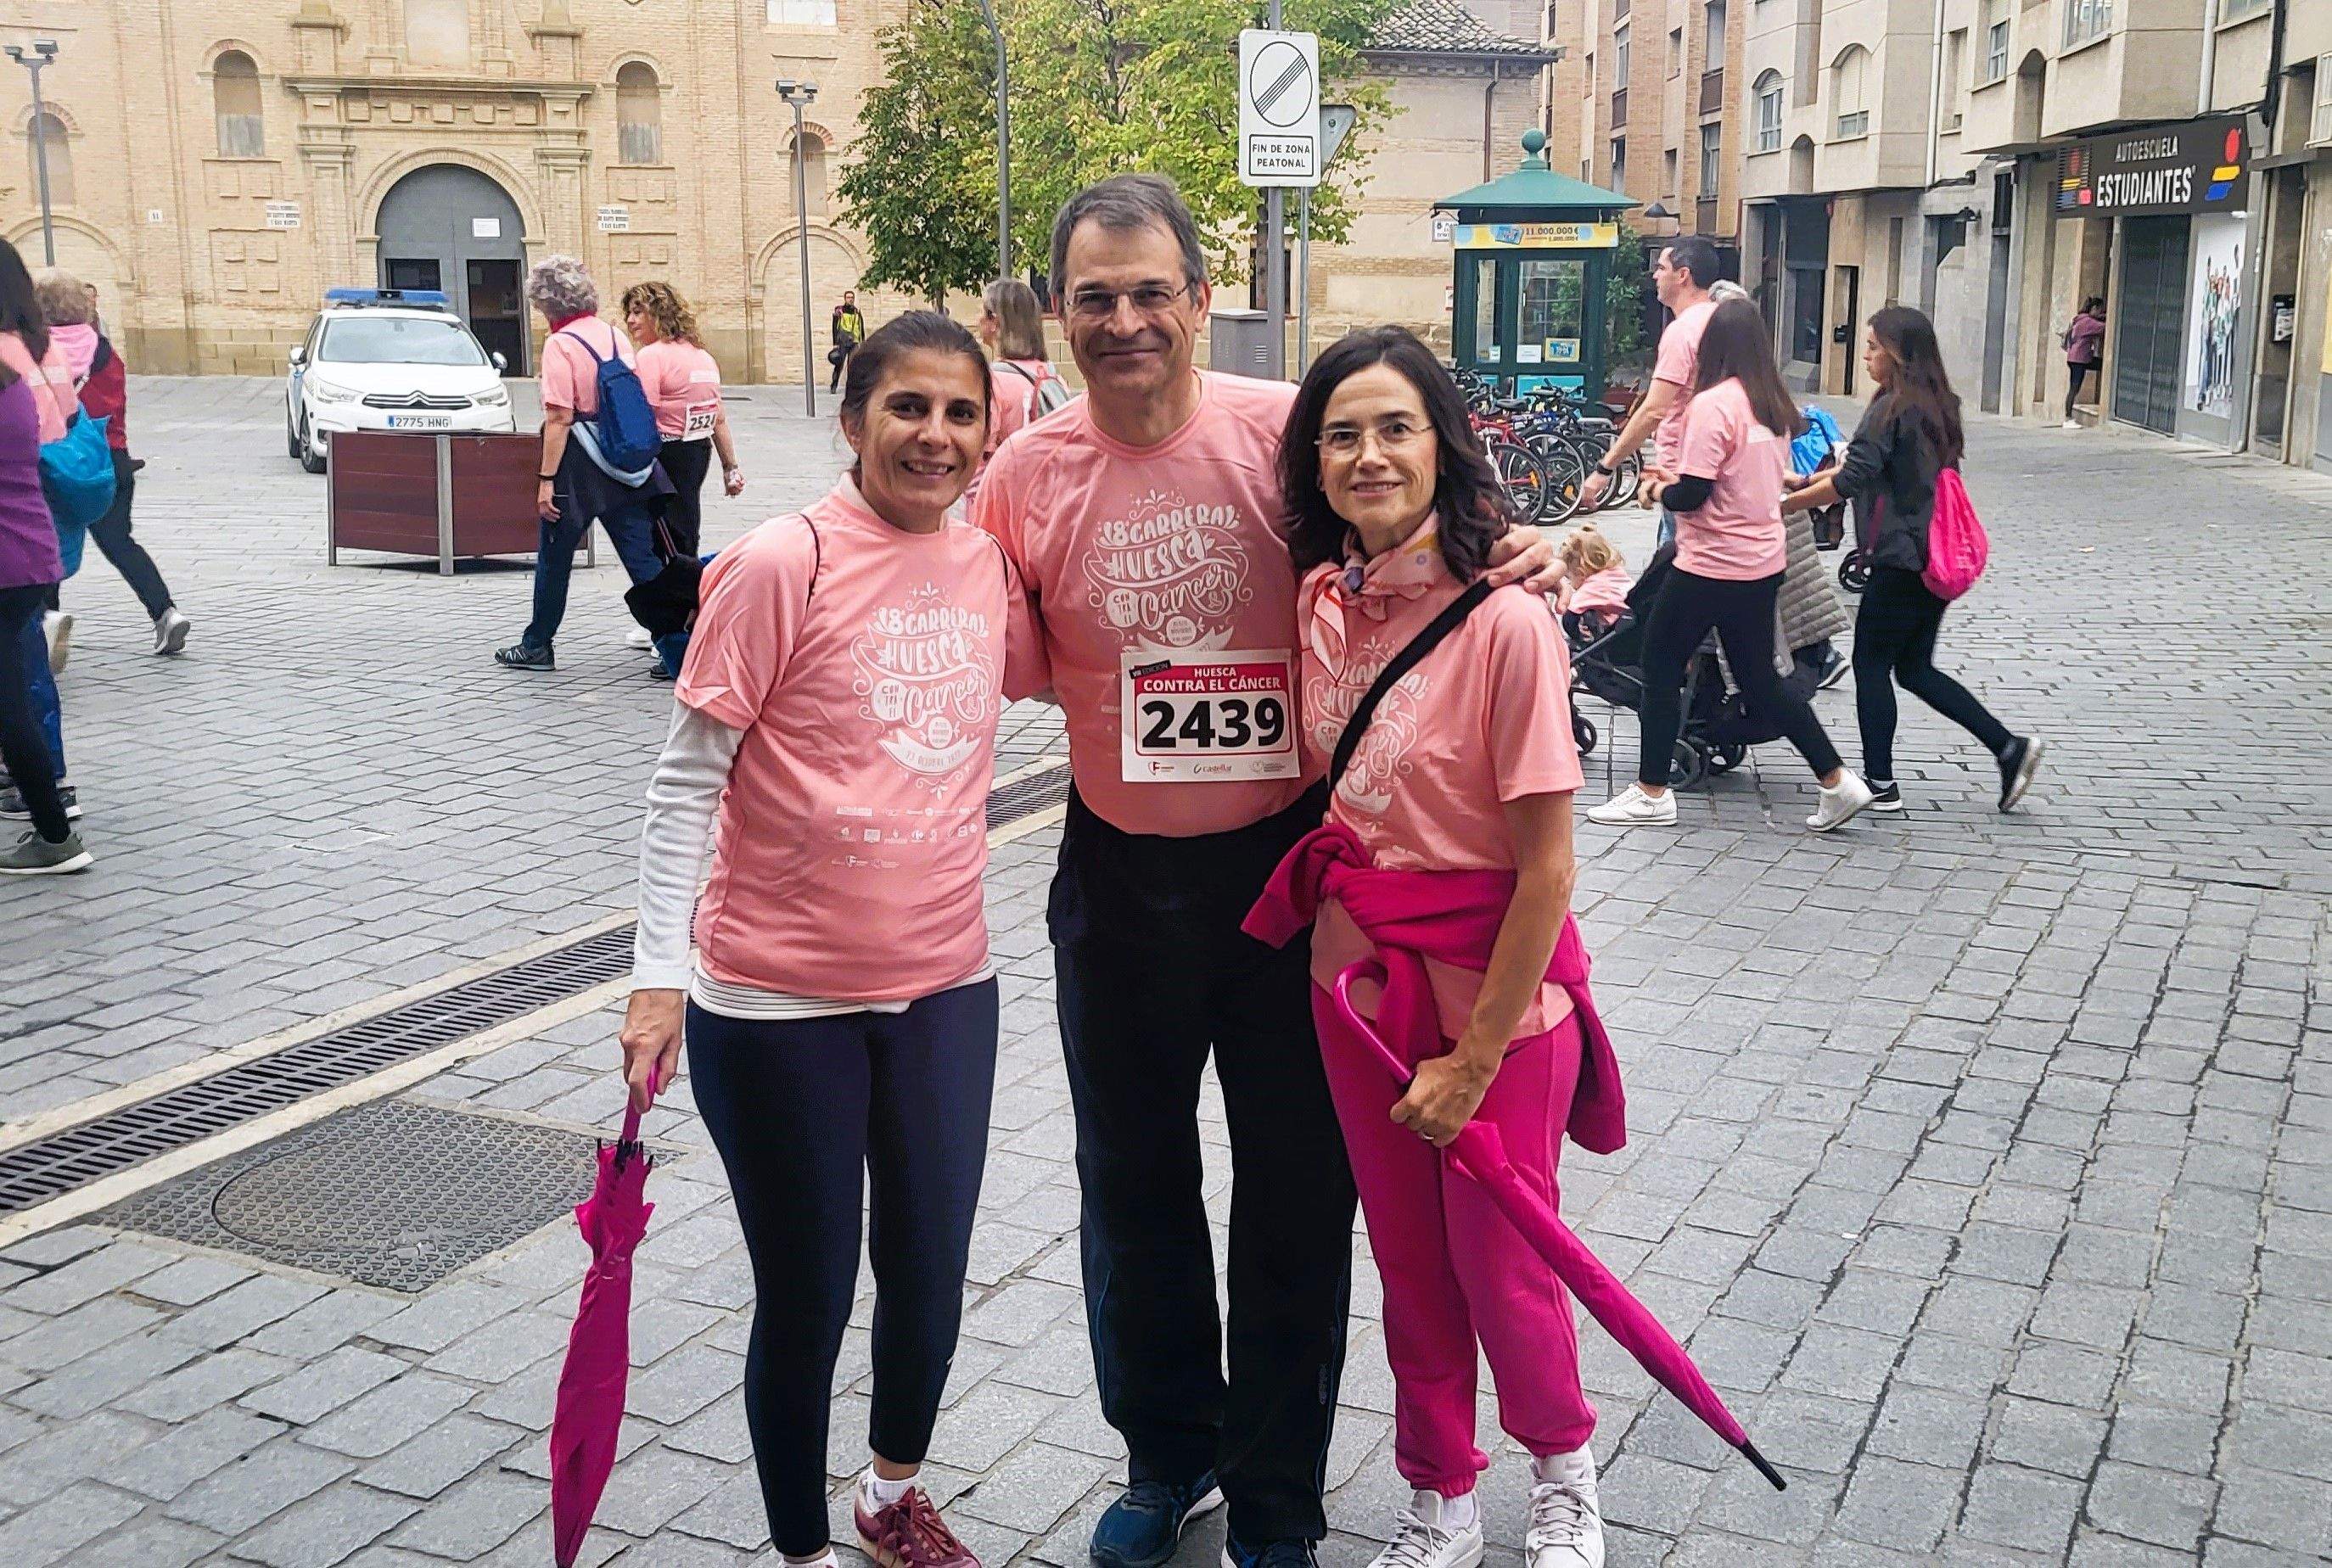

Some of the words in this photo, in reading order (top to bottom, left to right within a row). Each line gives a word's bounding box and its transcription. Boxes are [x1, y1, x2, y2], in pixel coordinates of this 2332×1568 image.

[1252, 144, 1267, 153] FIN
[1270, 144, 1282, 154] DE
[1286, 144, 1310, 154] ZONA
[2115, 136, 2178, 163] AUTOESCUELA
[1257, 158, 1306, 168] PEATONAL
[2095, 167, 2193, 208] ESTUDIANTES
[395, 417, 424, 428] 2775
[428, 417, 449, 428] HNG
[1194, 668, 1237, 678] HUESCA
[1143, 679, 1205, 692] CONTRA
[1209, 679, 1225, 692] EL
[1229, 676, 1281, 691] CÁNCER
[1141, 697, 1285, 748] 2439
